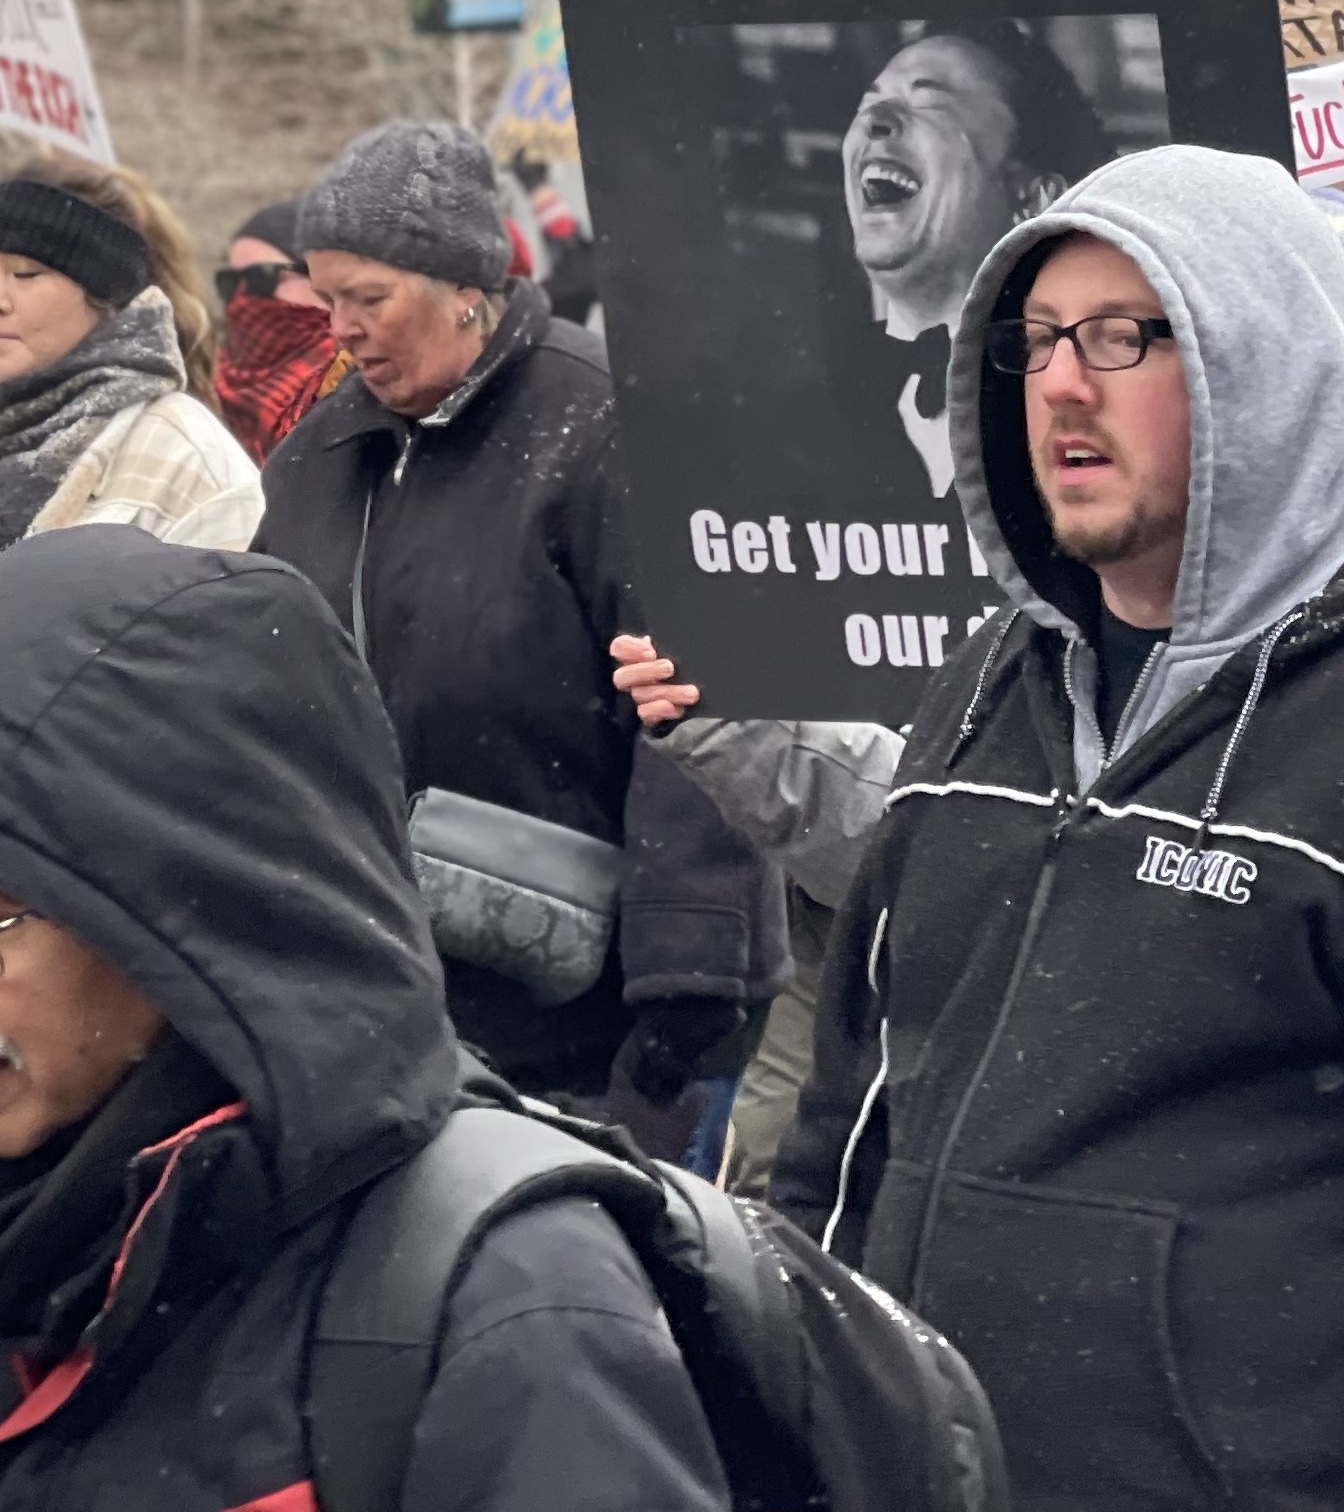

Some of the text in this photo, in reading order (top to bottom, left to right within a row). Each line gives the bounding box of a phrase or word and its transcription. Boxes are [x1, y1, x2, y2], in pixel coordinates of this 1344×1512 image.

[689, 508, 797, 574] Get
[806, 520, 950, 581] your
[844, 612, 950, 667] our
